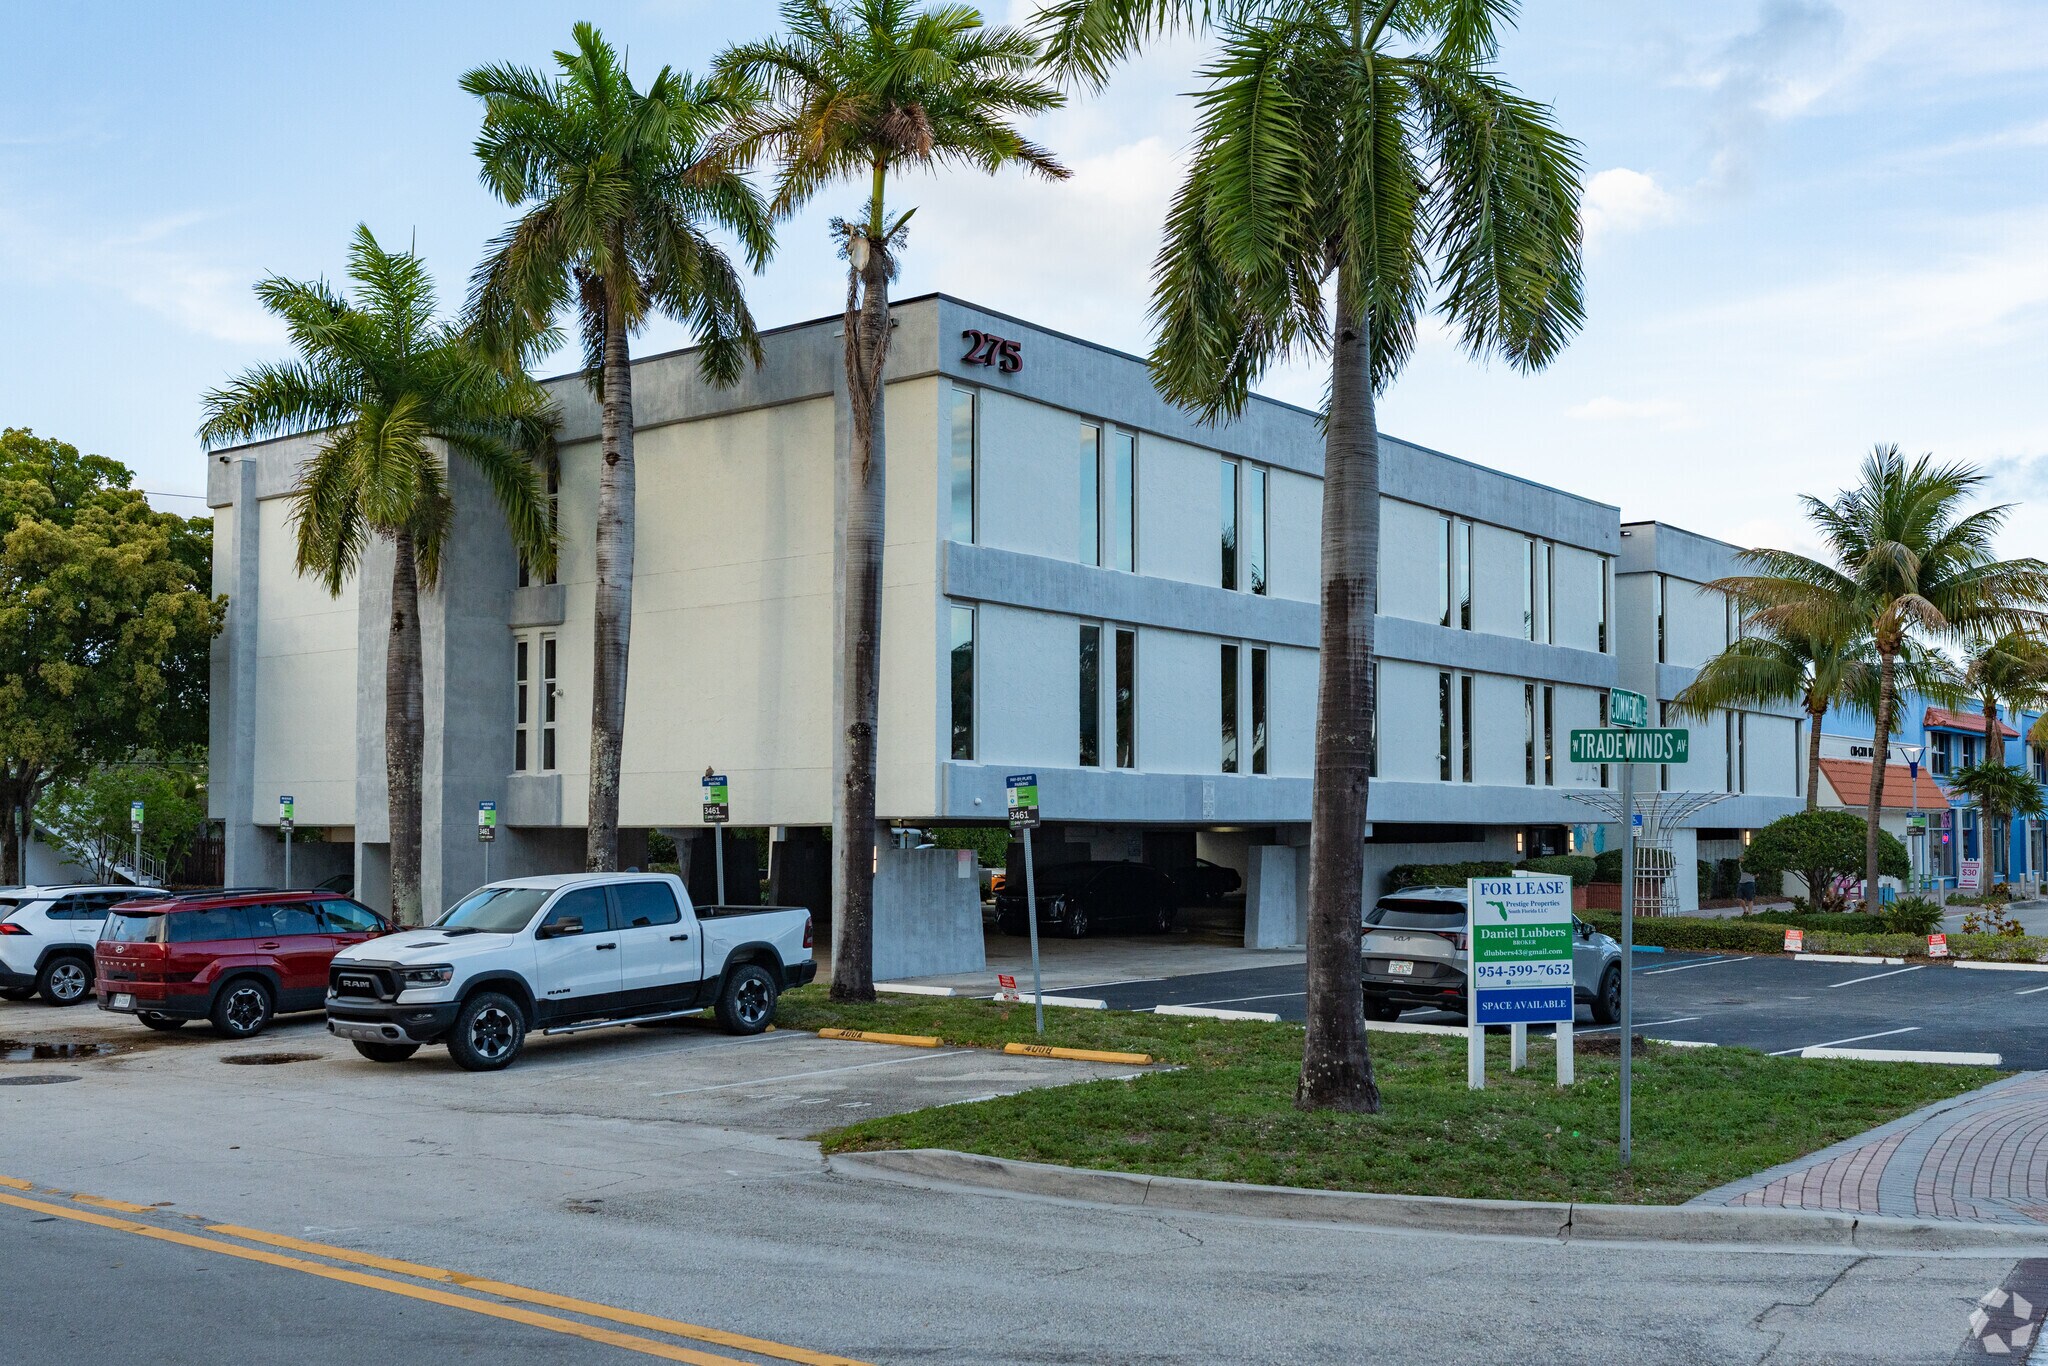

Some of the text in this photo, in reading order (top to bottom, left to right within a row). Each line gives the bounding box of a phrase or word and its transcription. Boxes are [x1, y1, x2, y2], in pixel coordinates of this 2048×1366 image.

[961, 329, 1024, 373] 275
[1579, 733, 1674, 759] TRADEWINDS
[703, 806, 721, 815] 3461
[1009, 810, 1029, 820] 3461
[1962, 868, 1977, 877] $30
[1480, 881, 1564, 896] FOR LEASE
[1481, 927, 1566, 939] Daniel Lubbers
[1483, 948, 1563, 957] dlubbers43@gmail.com
[1478, 963, 1570, 978] 954-599-7652
[342, 980, 370, 988] RAM
[547, 988, 571, 996] RAM
[1482, 999, 1567, 1010] SPACE AVAILABLE
